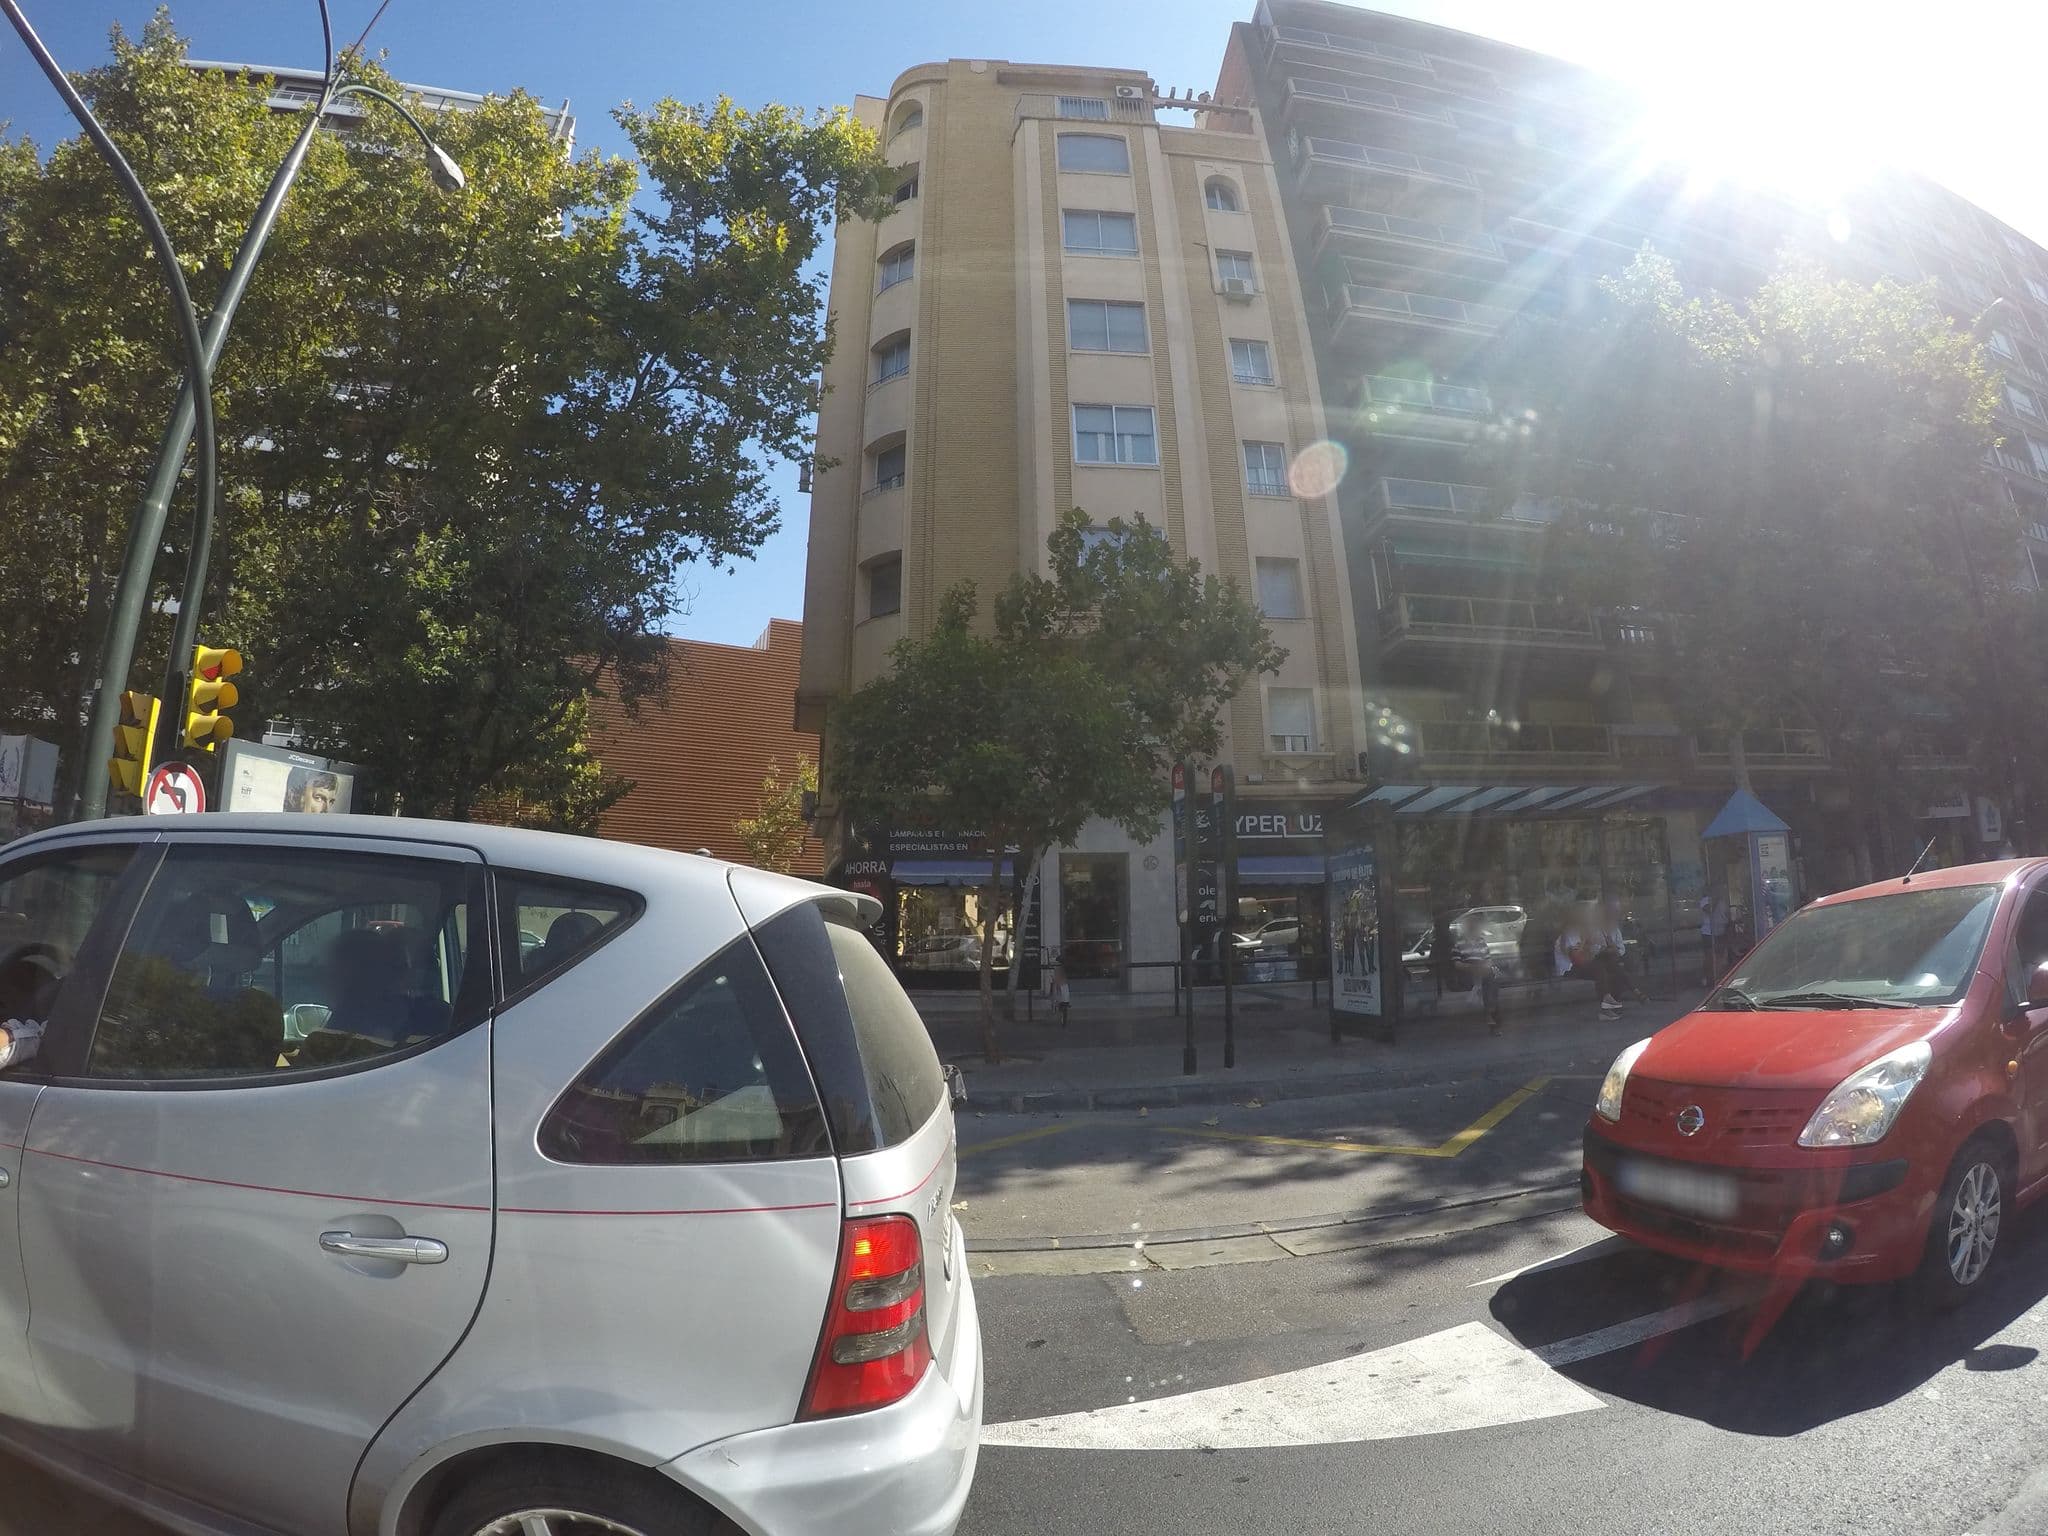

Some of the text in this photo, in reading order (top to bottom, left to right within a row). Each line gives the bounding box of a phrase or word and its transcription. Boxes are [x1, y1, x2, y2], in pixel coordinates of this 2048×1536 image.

[889, 843, 955, 851] ESPECIALISTAS
[956, 843, 969, 851] EN
[844, 860, 887, 875] AHORRA
